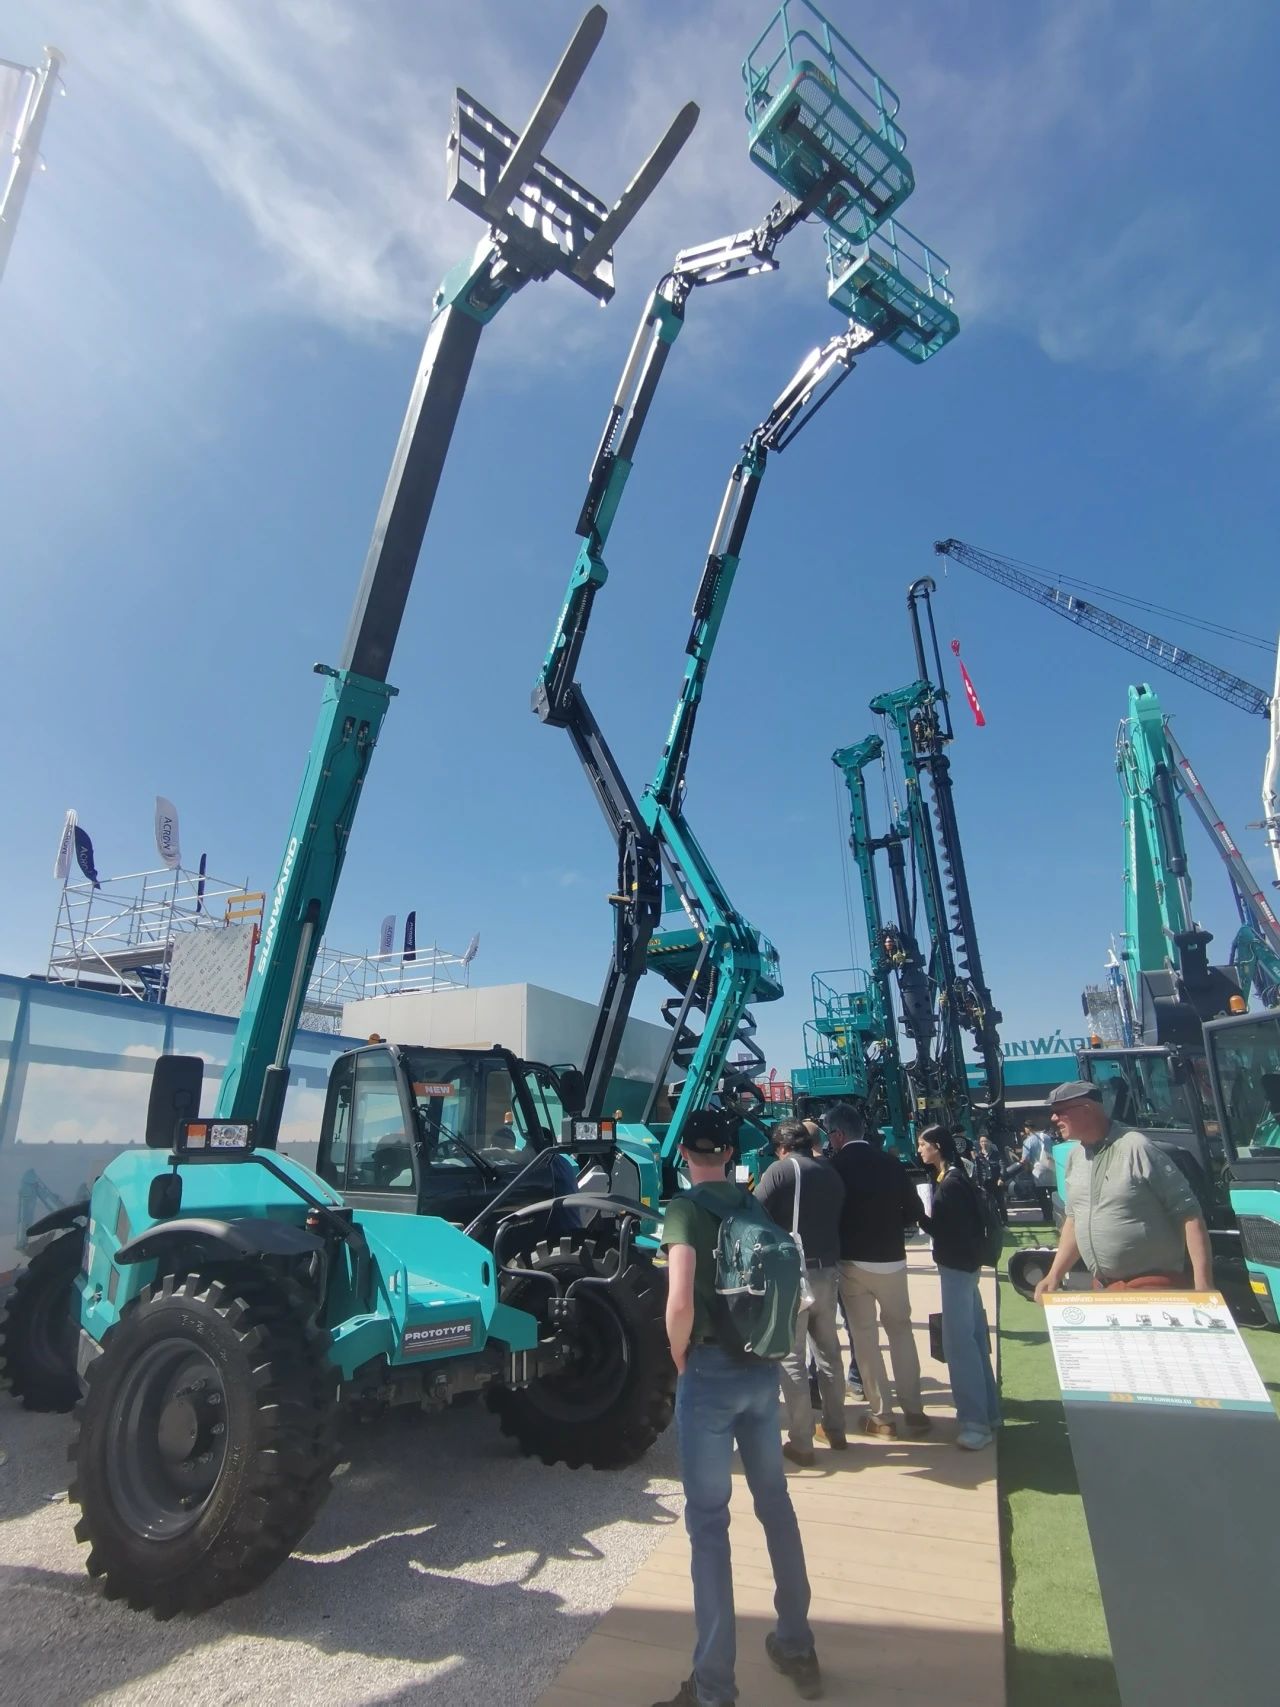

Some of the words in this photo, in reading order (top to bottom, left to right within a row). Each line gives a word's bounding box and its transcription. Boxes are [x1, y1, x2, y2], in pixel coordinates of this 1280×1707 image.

[162, 816, 173, 851] ACROW
[257, 836, 298, 977] SUNWARD
[425, 1085, 450, 1094] NEW
[404, 1324, 471, 1341] PROTOTYPE
